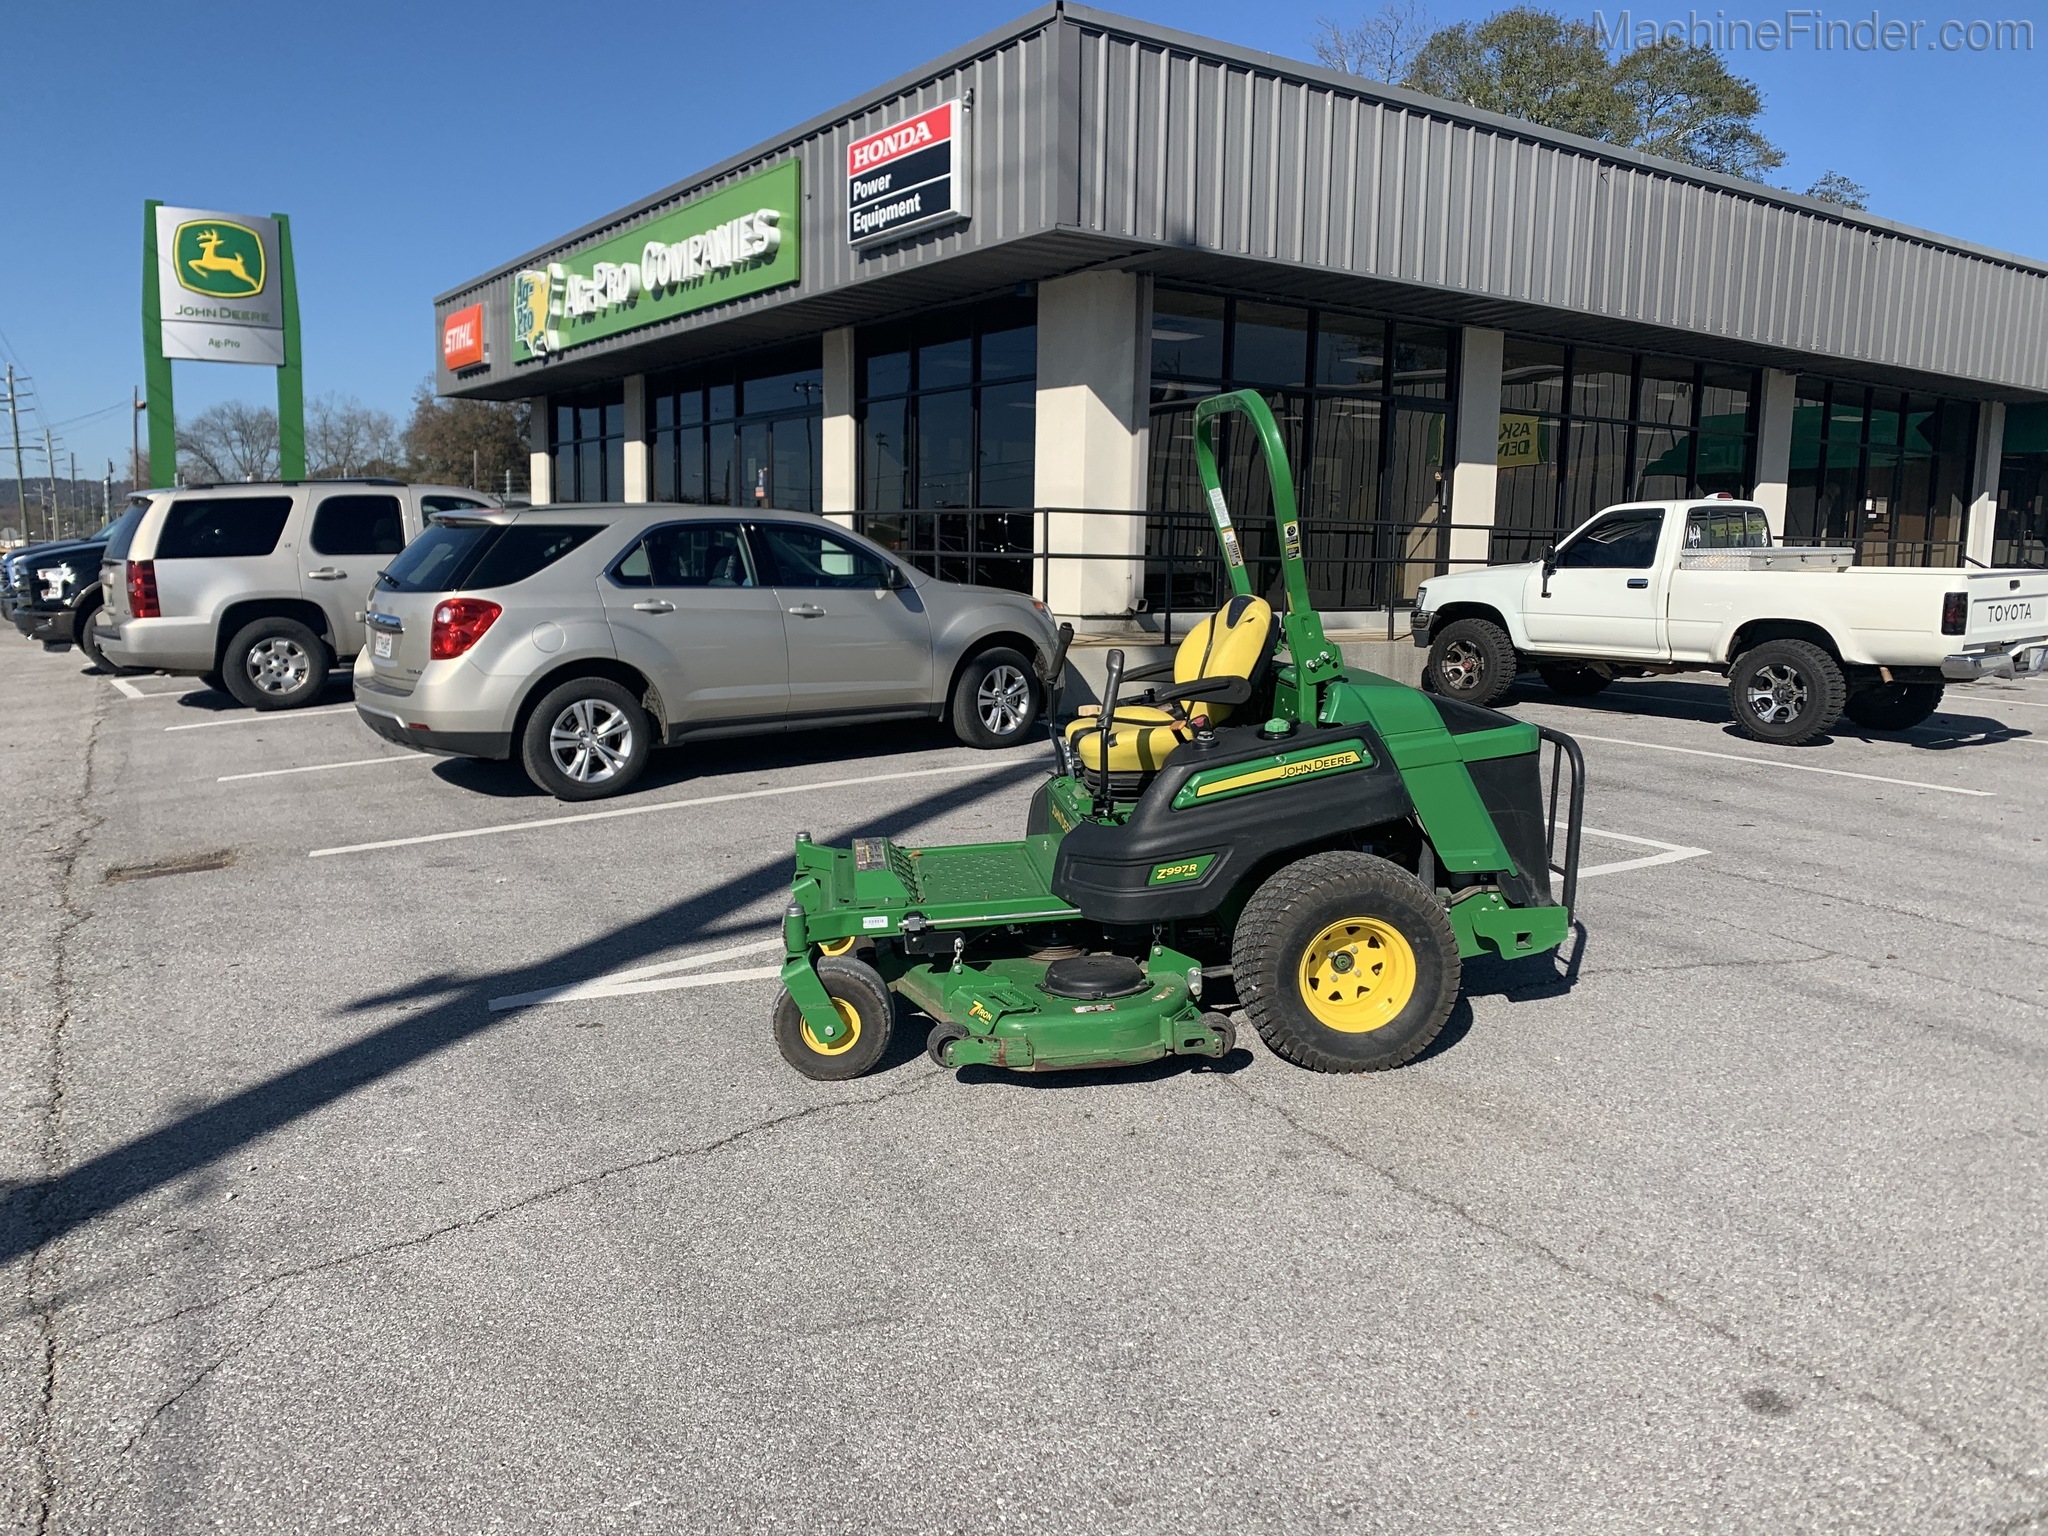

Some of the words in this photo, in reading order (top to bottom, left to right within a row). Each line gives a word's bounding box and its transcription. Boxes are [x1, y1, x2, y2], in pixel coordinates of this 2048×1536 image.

[852, 121, 933, 169] HONDA
[852, 173, 893, 201] Power
[852, 193, 921, 233] Equipment
[175, 304, 217, 318] JOHN
[219, 307, 271, 323] DEERE
[208, 338, 241, 349] Ag-Pro
[444, 324, 474, 354] STIHL
[1987, 603, 2032, 622] TOYOTA
[1280, 763, 1312, 778] JOHN
[1314, 755, 1352, 770] DEERE
[1156, 863, 1198, 880] Z997R
